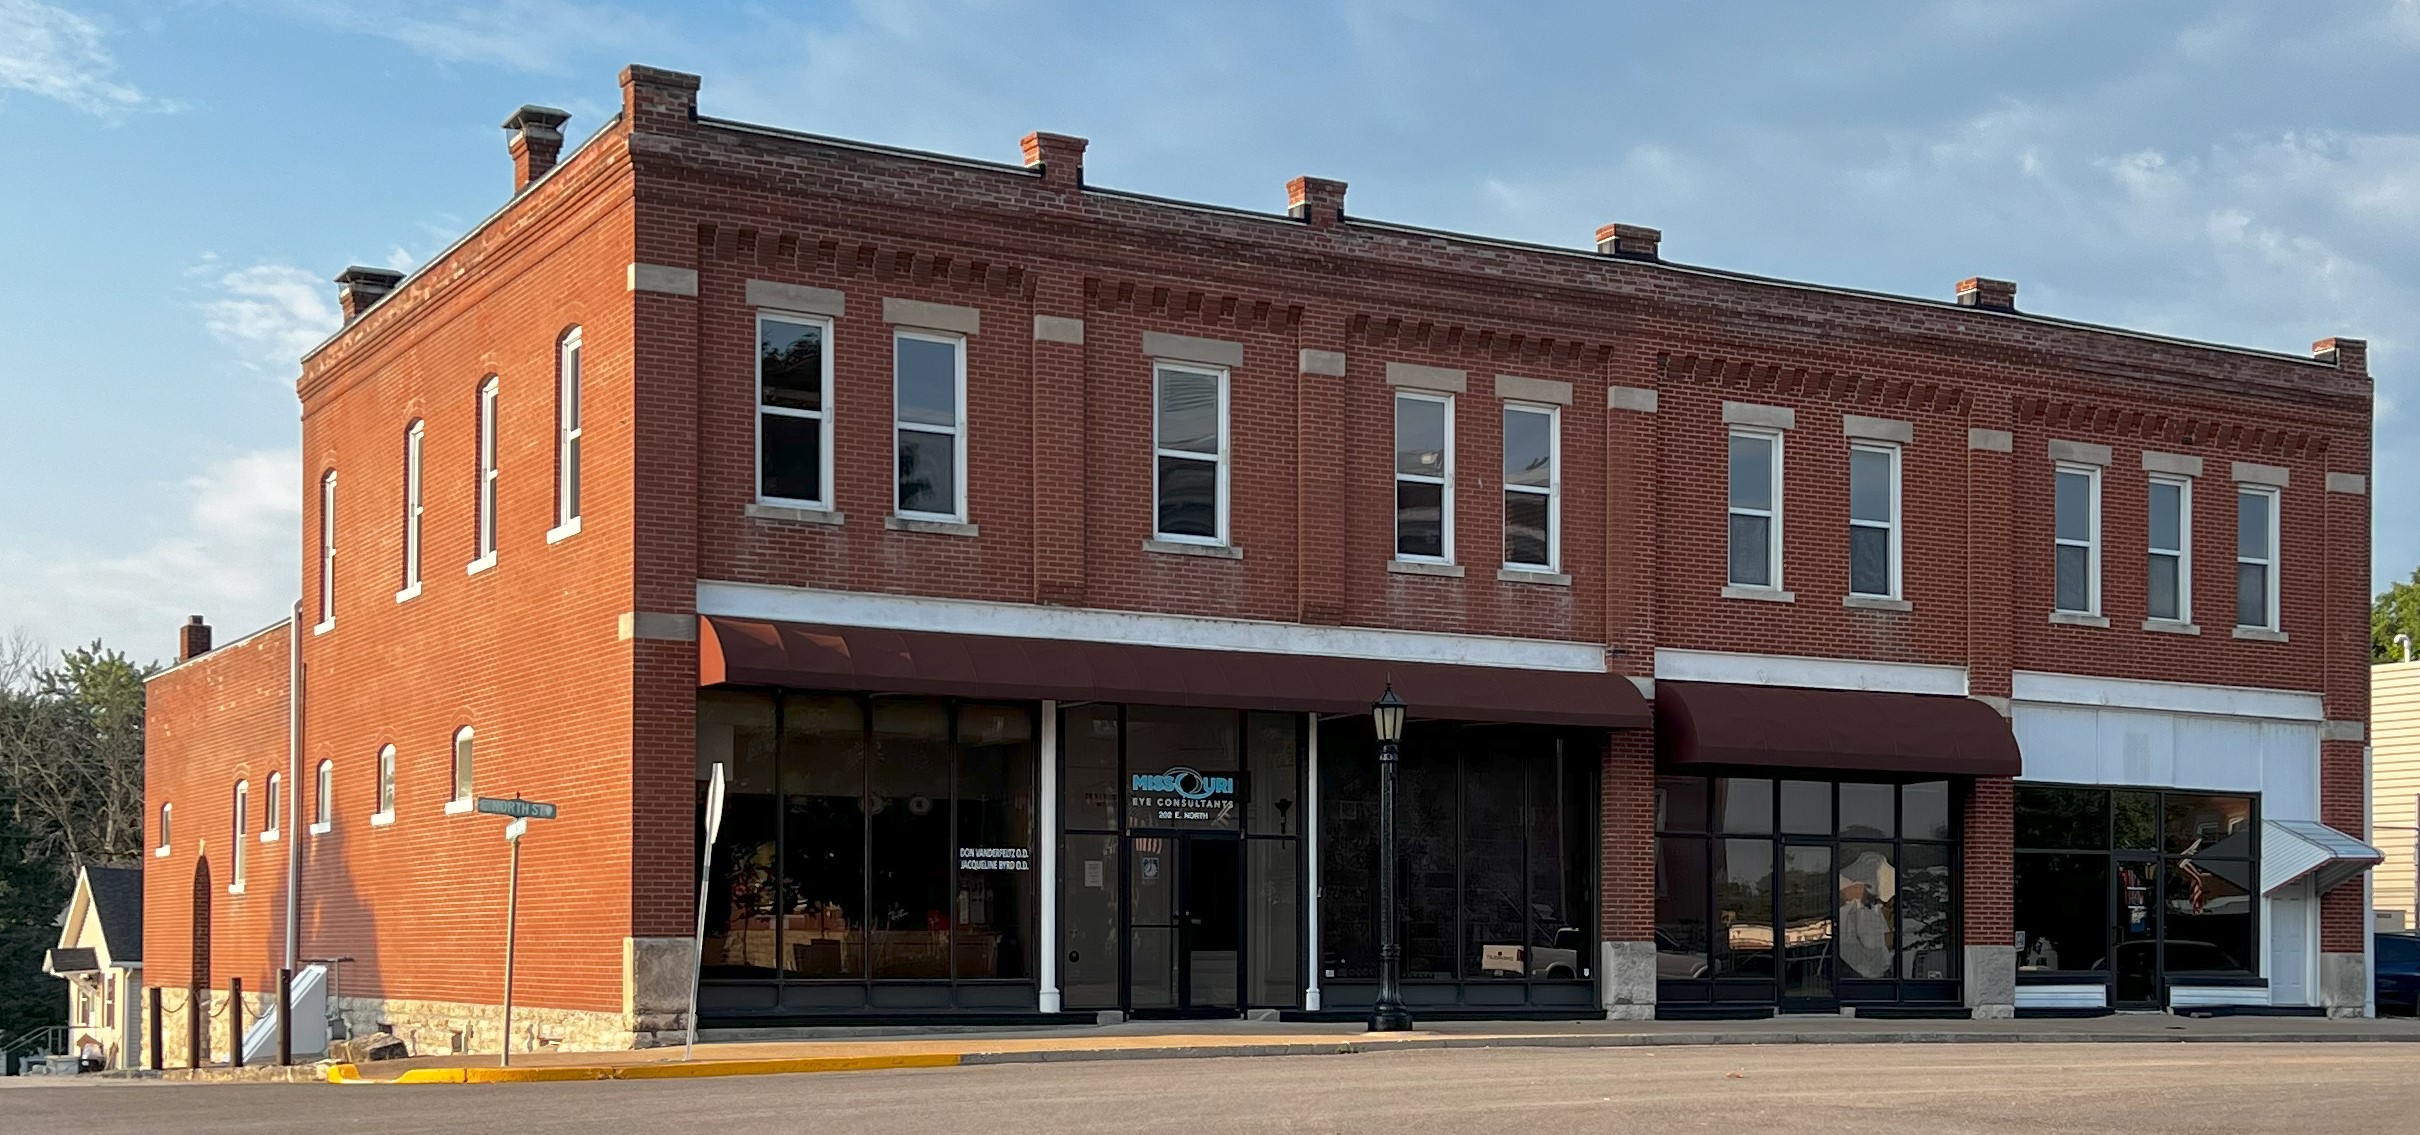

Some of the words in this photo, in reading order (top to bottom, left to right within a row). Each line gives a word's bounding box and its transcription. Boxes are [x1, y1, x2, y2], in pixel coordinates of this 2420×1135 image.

[1132, 771, 1233, 798] MISSOURI
[492, 800, 530, 815] NORTH
[1132, 798, 1151, 806] EYE
[1156, 799, 1233, 808] CONSULTANTS
[1183, 811, 1209, 820] NORTH
[960, 847, 975, 858] DON
[960, 860, 998, 870] JACQUELINE
